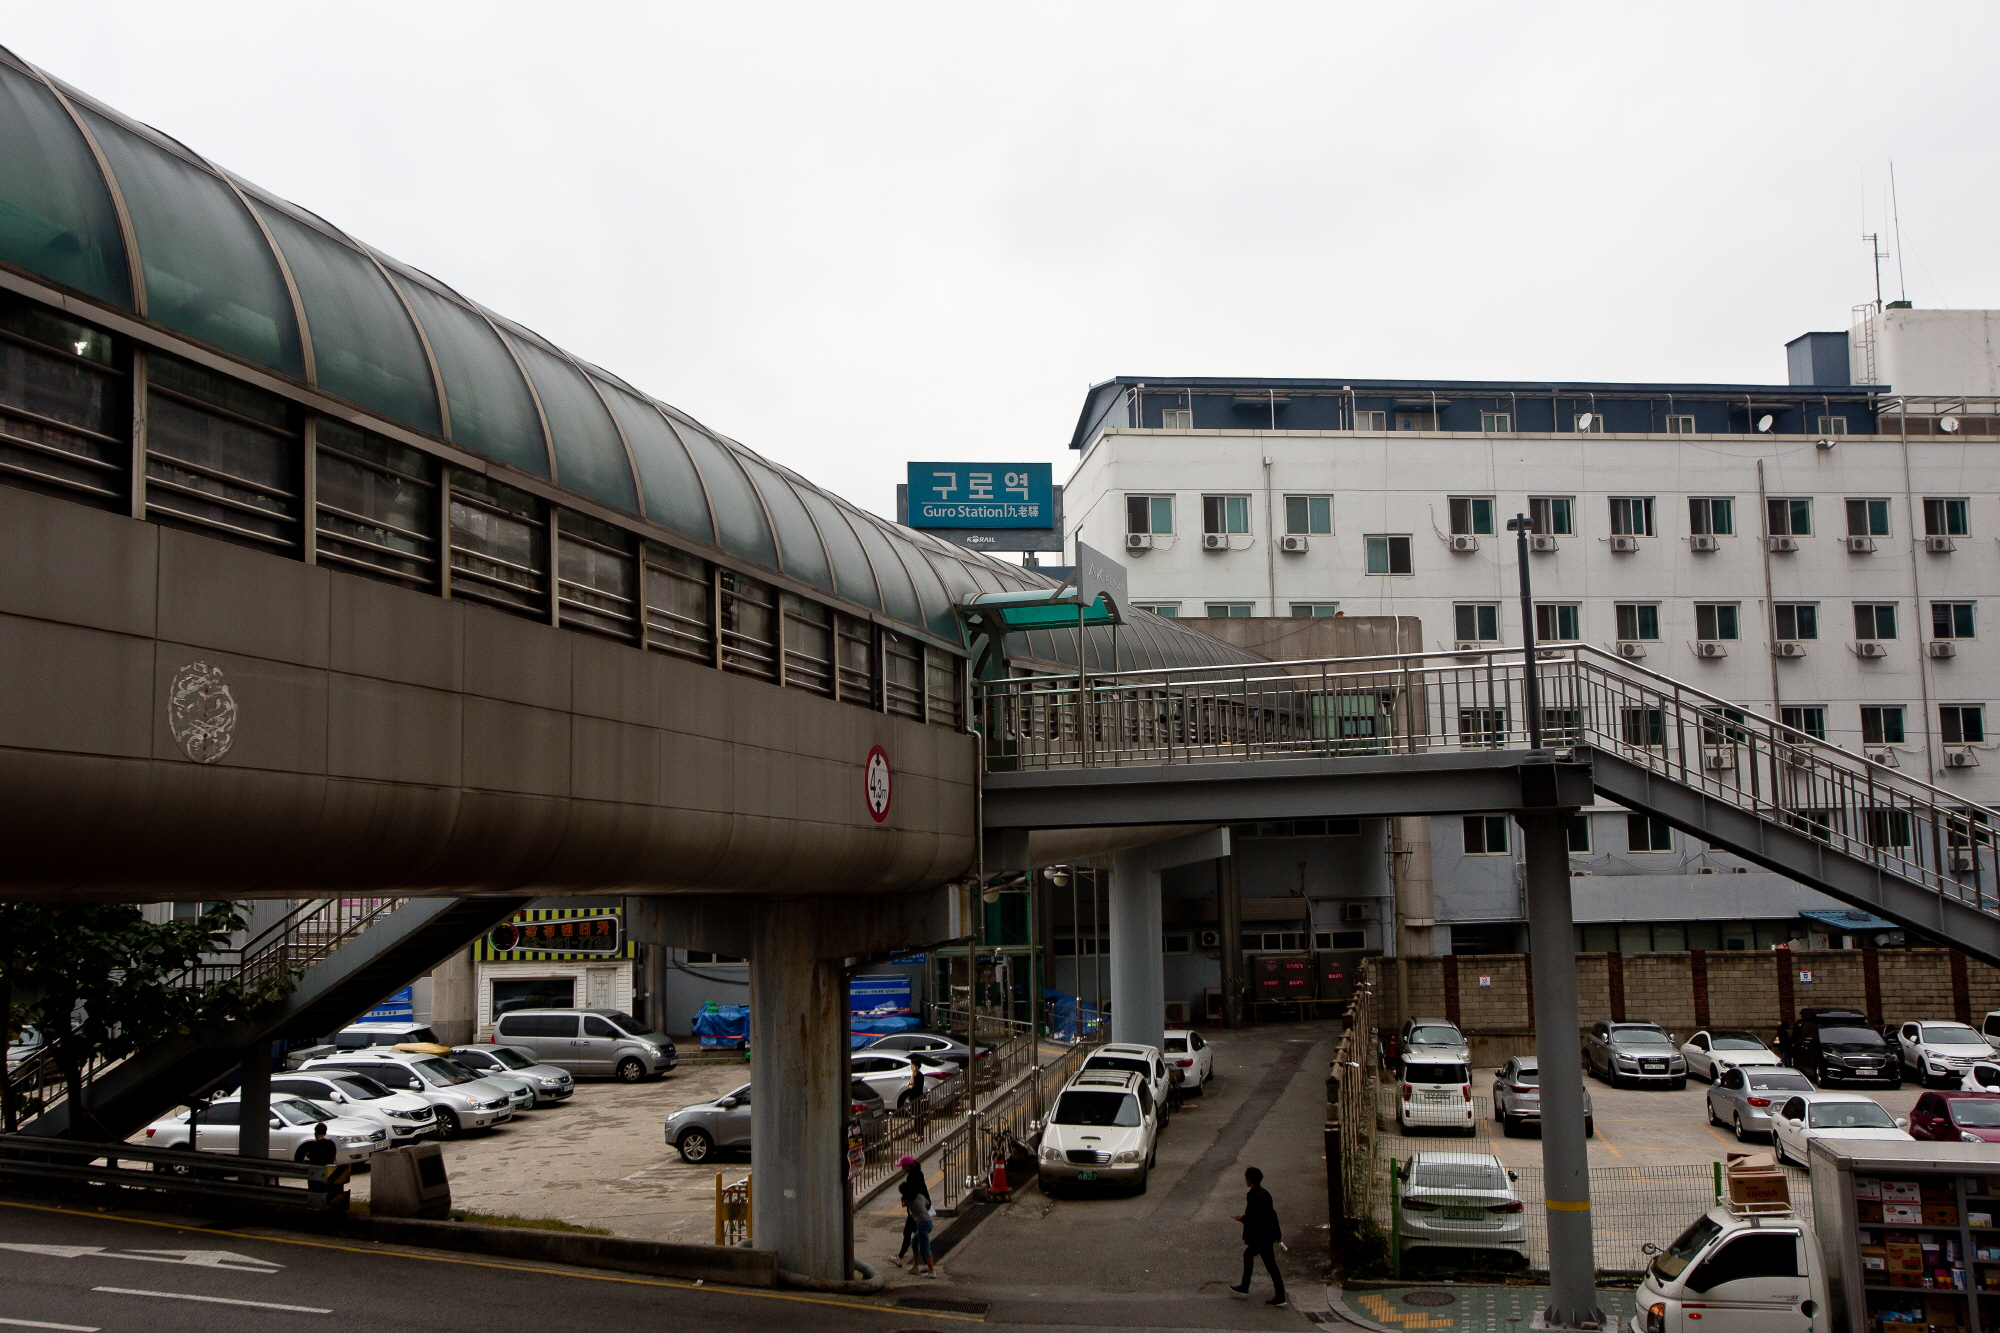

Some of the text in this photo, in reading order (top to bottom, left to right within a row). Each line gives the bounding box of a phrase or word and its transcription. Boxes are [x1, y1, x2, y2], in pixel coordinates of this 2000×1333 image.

[932, 472, 1029, 500] 구로역
[923, 505, 1003, 518] Guro Station
[966, 535, 996, 543] KORAIL
[522, 936, 612, 949] 02-861-7789
[1746, 1189, 1777, 1198] ENEMA
